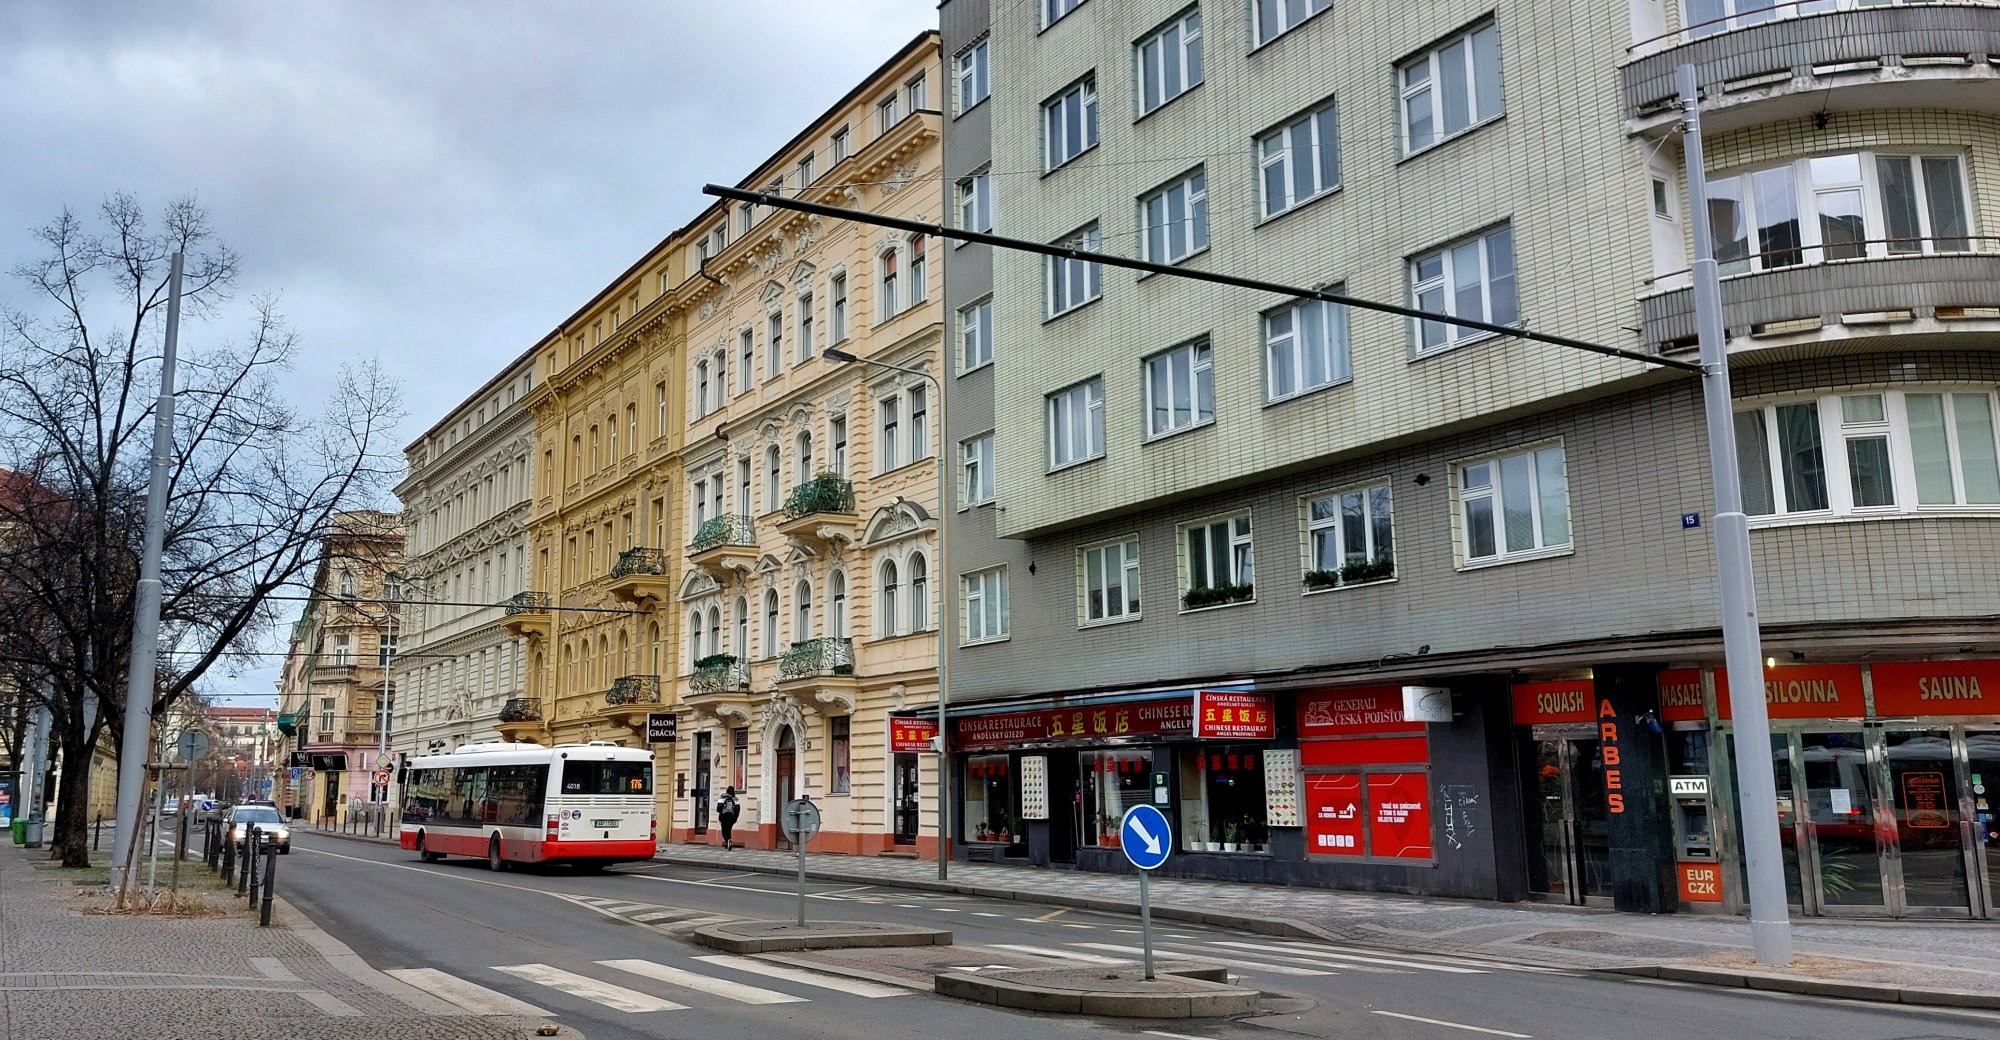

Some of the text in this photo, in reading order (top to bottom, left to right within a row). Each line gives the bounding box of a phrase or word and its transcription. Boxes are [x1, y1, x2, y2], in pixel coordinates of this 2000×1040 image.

[1685, 515, 1695, 525] 15
[1919, 676, 1983, 700] SAUNA
[1205, 694, 1266, 703] ČÍNSKÁ RESTAURACE
[1334, 697, 1376, 711] GENERALI
[1537, 691, 1584, 714] SQUASH
[1138, 705, 1181, 720] CHINESE
[1205, 708, 1267, 723] 五星饭店
[1334, 710, 1362, 725] ČESKÁ
[651, 718, 674, 727] SALON
[960, 716, 1042, 733] ČÍNSKÁ RESTAURACE
[1052, 709, 1130, 737] 五星饭店
[1160, 719, 1186, 730] ANGEL
[650, 728, 676, 737] GRÁCIA
[896, 730, 931, 741] 五星饭
[1004, 729, 1025, 739] ÚJEZD
[1600, 699, 1625, 814] ARBES
[1674, 781, 1705, 791] ATM
[1686, 869, 1714, 881] EUR
[1687, 882, 1716, 895] CZK
